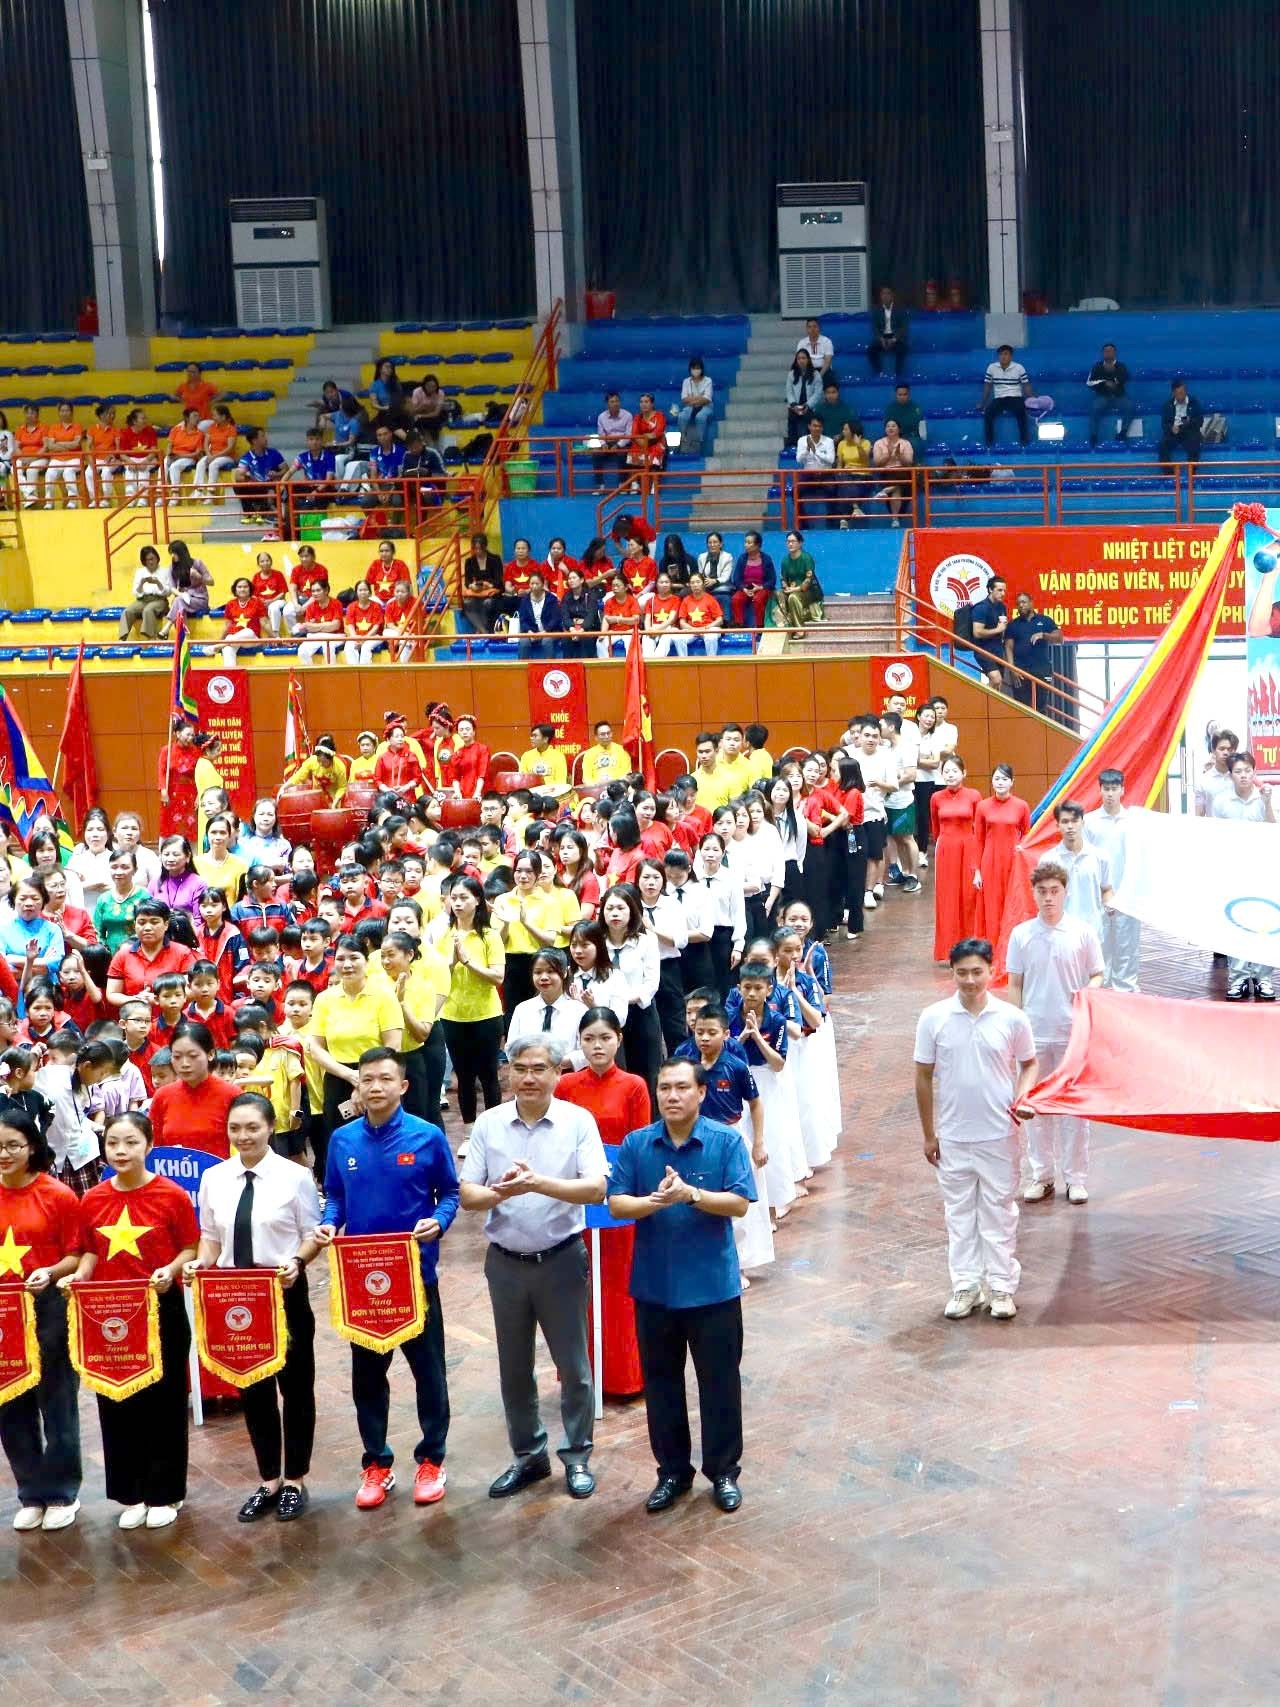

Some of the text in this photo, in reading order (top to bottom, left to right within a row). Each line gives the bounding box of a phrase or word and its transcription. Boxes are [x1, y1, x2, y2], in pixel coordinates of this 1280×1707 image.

[1103, 537, 1148, 564] NHIỆT
[1153, 537, 1185, 563] LIỆT
[1039, 569, 1071, 595] VẬN
[1075, 570, 1119, 594] ĐỘNG
[1123, 568, 1164, 591] VIÊN,
[1169, 565, 1201, 589] HUẤ
[1073, 600, 1103, 625] THỂ
[1107, 607, 1139, 628] DỤC
[1143, 600, 1172, 624] THỂ
[550, 709, 570, 723] KHỎE
[154, 1154, 199, 1179] KHỐI
